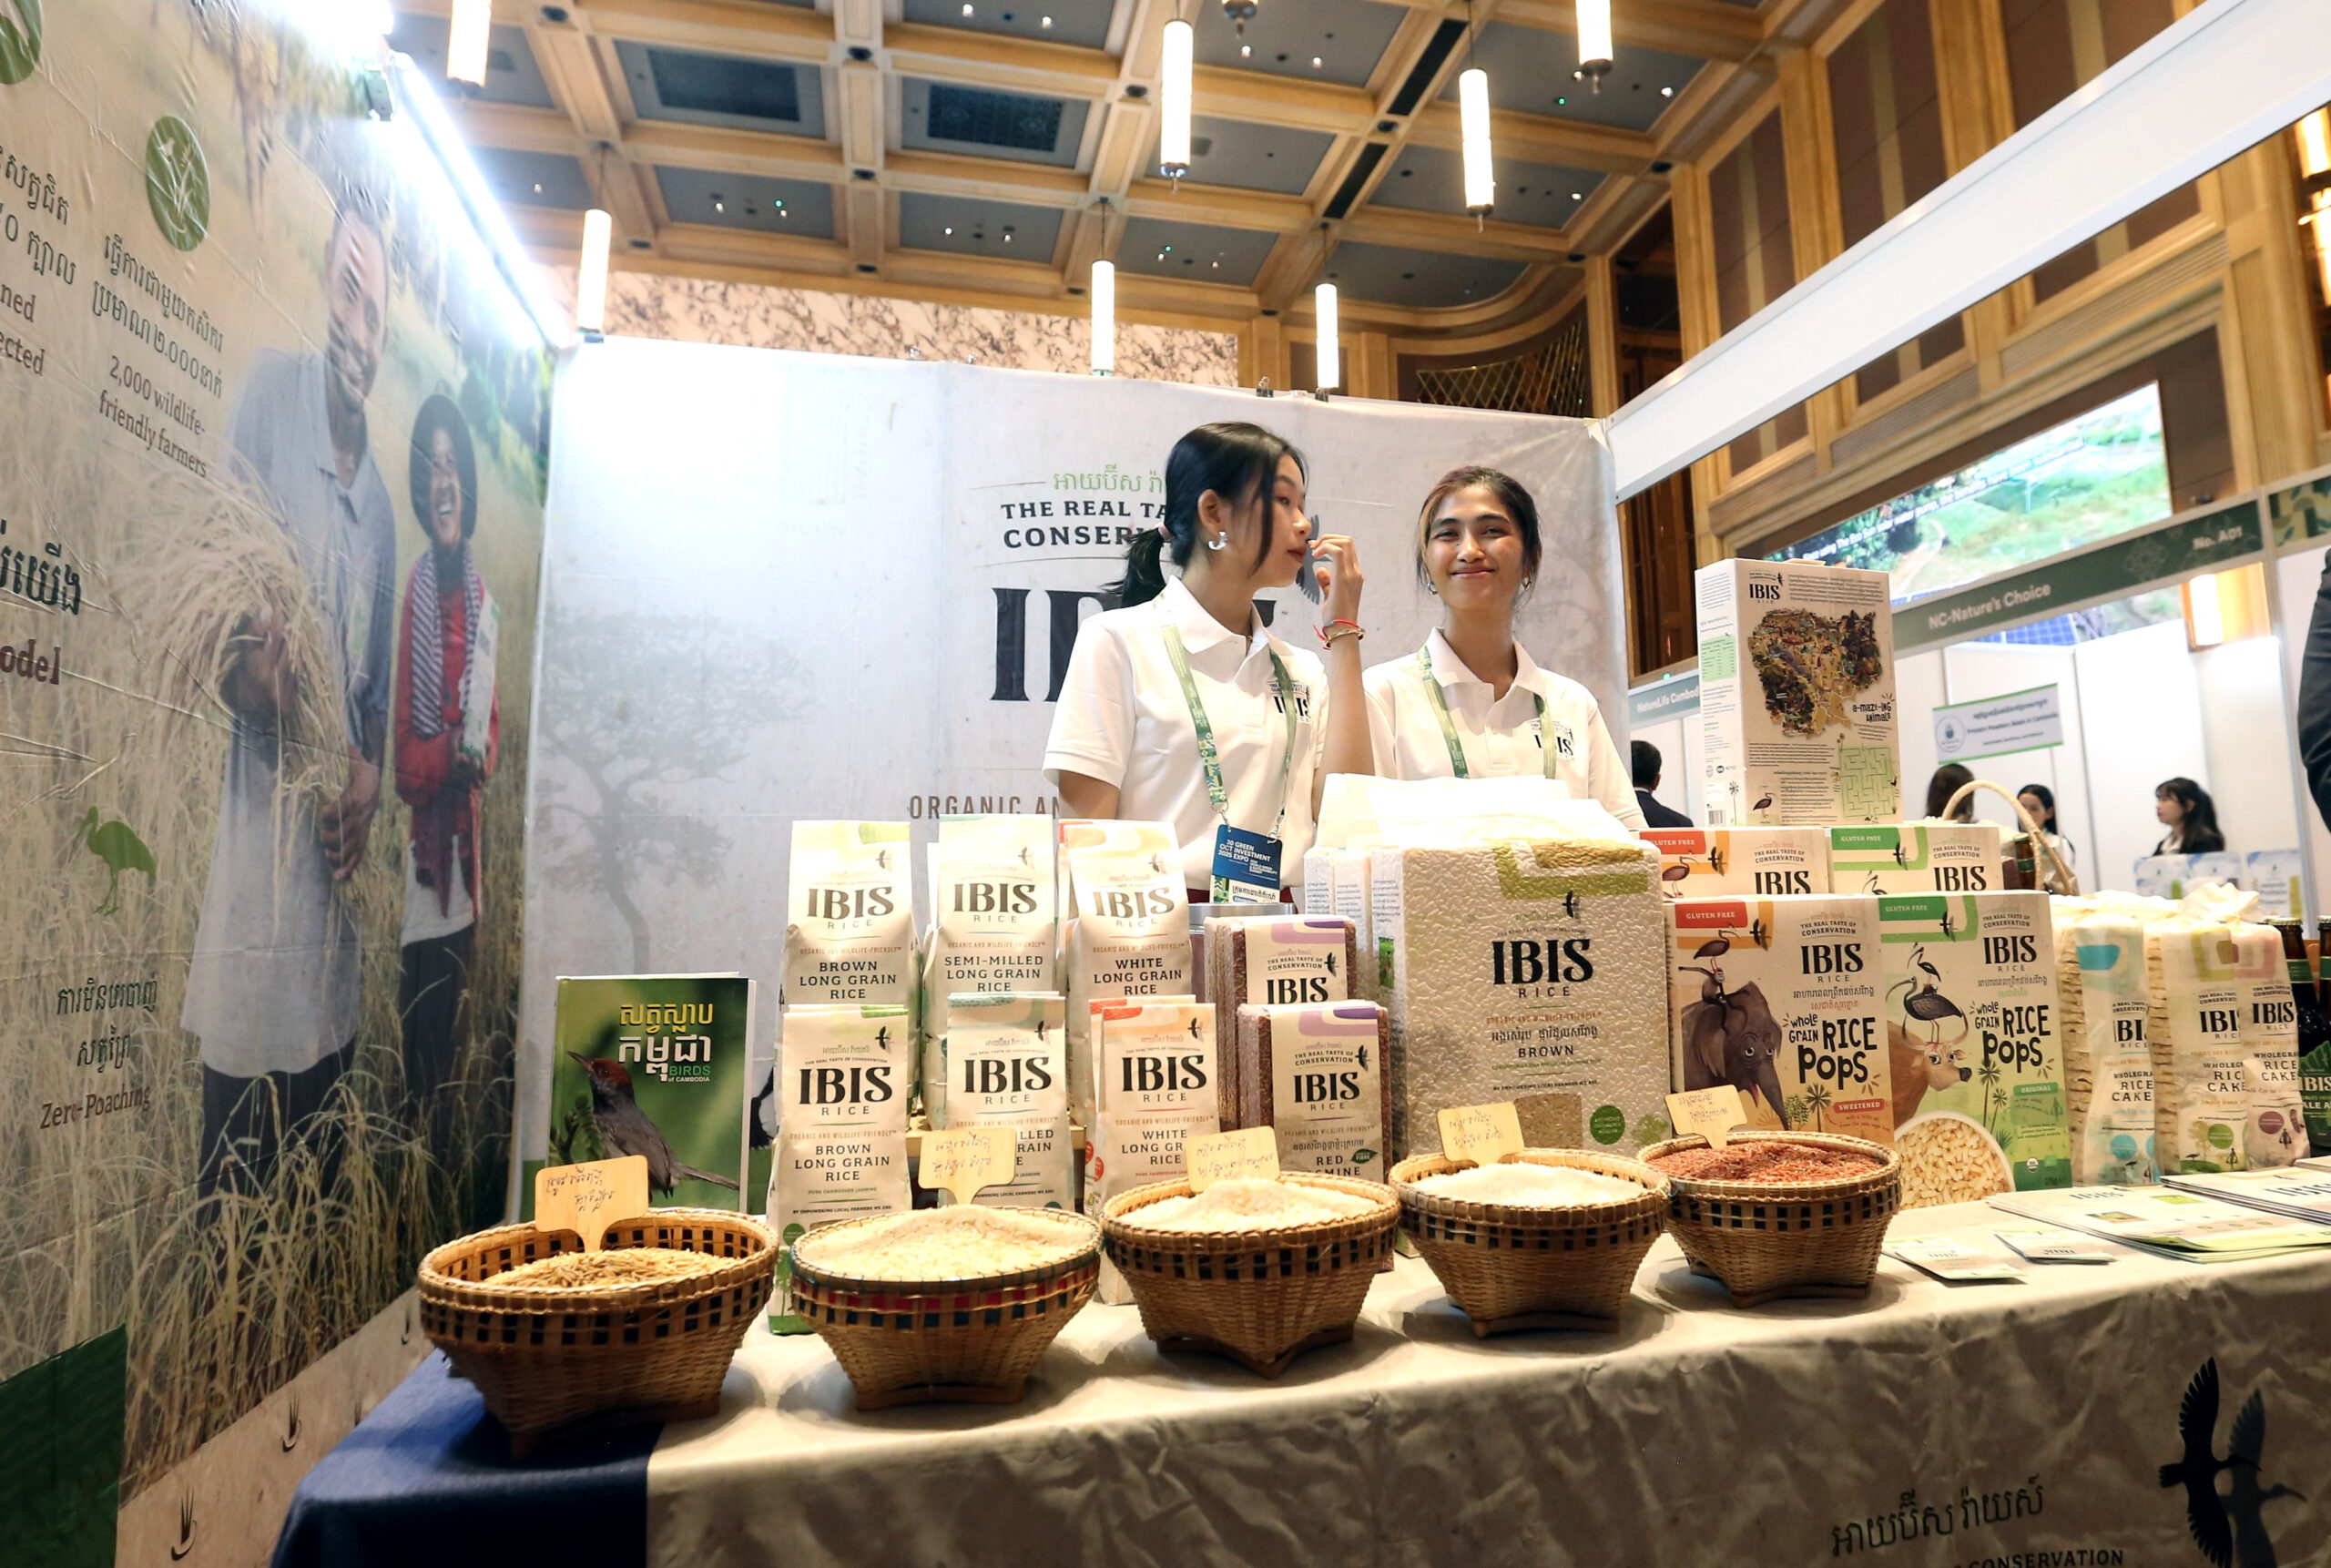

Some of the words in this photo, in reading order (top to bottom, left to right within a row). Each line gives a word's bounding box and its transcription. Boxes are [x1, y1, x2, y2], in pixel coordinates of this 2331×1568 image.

[109, 355, 151, 402] 2,000
[154, 386, 206, 436] wildlife-
[98, 390, 157, 452] friendly
[158, 428, 208, 478] farmers
[1001, 502, 1054, 519] THE
[1064, 501, 1131, 517] REAL
[1003, 525, 1138, 549] CONSER
[1749, 583, 1780, 600] IBIS
[1928, 596, 2001, 630] NC-Nature's
[2004, 583, 2051, 613] Choice
[1670, 685, 1699, 703] Cambod
[1534, 734, 1573, 756] IIS
[910, 795, 1021, 820] ORGANIC
[1235, 840, 1255, 851] GREEN
[1219, 843, 1233, 852] OCT
[1234, 848, 1271, 862] INVESTMENT
[1233, 853, 1249, 862] EXPO
[1933, 850, 1980, 859] CONSERVATION
[1755, 855, 1805, 863] CONSERVATION
[1756, 871, 1811, 894] IBIS
[1934, 866, 1987, 891] IBIS
[807, 886, 894, 920] IBIS
[953, 883, 1037, 913] IBIS
[1093, 888, 1175, 918] IBIS
[973, 914, 1017, 923] RICE
[1115, 918, 1158, 929] RICE
[1983, 919, 2031, 928] CONSERVATION
[828, 919, 873, 930] RICE
[1801, 927, 1857, 936] CONSERVATION
[1983, 935, 2037, 965] IBIS
[944, 956, 1043, 966] SEMI-MILLED
[1115, 957, 1164, 969] WHITE
[1491, 939, 1593, 984] IBIS
[1801, 943, 1864, 974] IBIS
[819, 962, 878, 972] BROWN
[1267, 962, 1323, 971] CONSERVATION
[1998, 964, 2026, 972] RICE
[799, 976, 841, 986] LONG
[848, 974, 897, 985] GRAIN
[947, 970, 991, 980] LONG
[994, 969, 1041, 979] GRAIN
[1094, 973, 1134, 984] LONG
[1140, 970, 1183, 982] GRAIN
[977, 983, 1012, 992] RICE
[1124, 984, 1157, 996] RICE
[1267, 977, 1328, 1004] IBIS
[1519, 987, 1571, 998] RICE
[830, 989, 866, 1000] RICE
[2252, 1002, 2295, 1023] IBIS
[2002, 1005, 2051, 1038] RICE
[2199, 1010, 2240, 1033] IBI
[1822, 1017, 1878, 1053] RICE
[1518, 1045, 1574, 1058] BROWN
[1295, 1056, 1354, 1066] CONSERVATION
[2264, 1061, 2297, 1070] RICE
[668, 1065, 711, 1076] BIRDS
[964, 1056, 1052, 1094] IBIS
[1122, 1055, 1207, 1092] IBIS
[2113, 1071, 2153, 1079] WHOLEGRA
[2261, 1072, 2296, 1081] CAKE
[799, 1066, 893, 1105] IBIS
[1294, 1072, 1360, 1104] IBIS
[2021, 1084, 2052, 1094] ORIGINAL
[2121, 1080, 2154, 1091] RICE
[2207, 1082, 2245, 1092] CAKE
[985, 1094, 1031, 1105] RICE
[1143, 1093, 1187, 1103] RICE
[2112, 1092, 2153, 1102] CAKE
[40, 1084, 151, 1130] Zero-Poaching
[821, 1105, 870, 1115] RICE
[1310, 1102, 1345, 1111] RICE
[1838, 1102, 1880, 1110] SWEETENED
[2303, 1101, 2322, 1109] ALE
[1142, 1129, 1187, 1140] WHITE
[815, 1144, 871, 1155] BROWN
[1017, 1142, 1052, 1153] RAIN
[1122, 1143, 1159, 1154] LONG
[795, 1158, 836, 1169] LONG
[842, 1156, 891, 1167] GRAIN
[1150, 1155, 1182, 1165] RICE
[1317, 1155, 1344, 1166] RED
[826, 1171, 860, 1181] RICE
